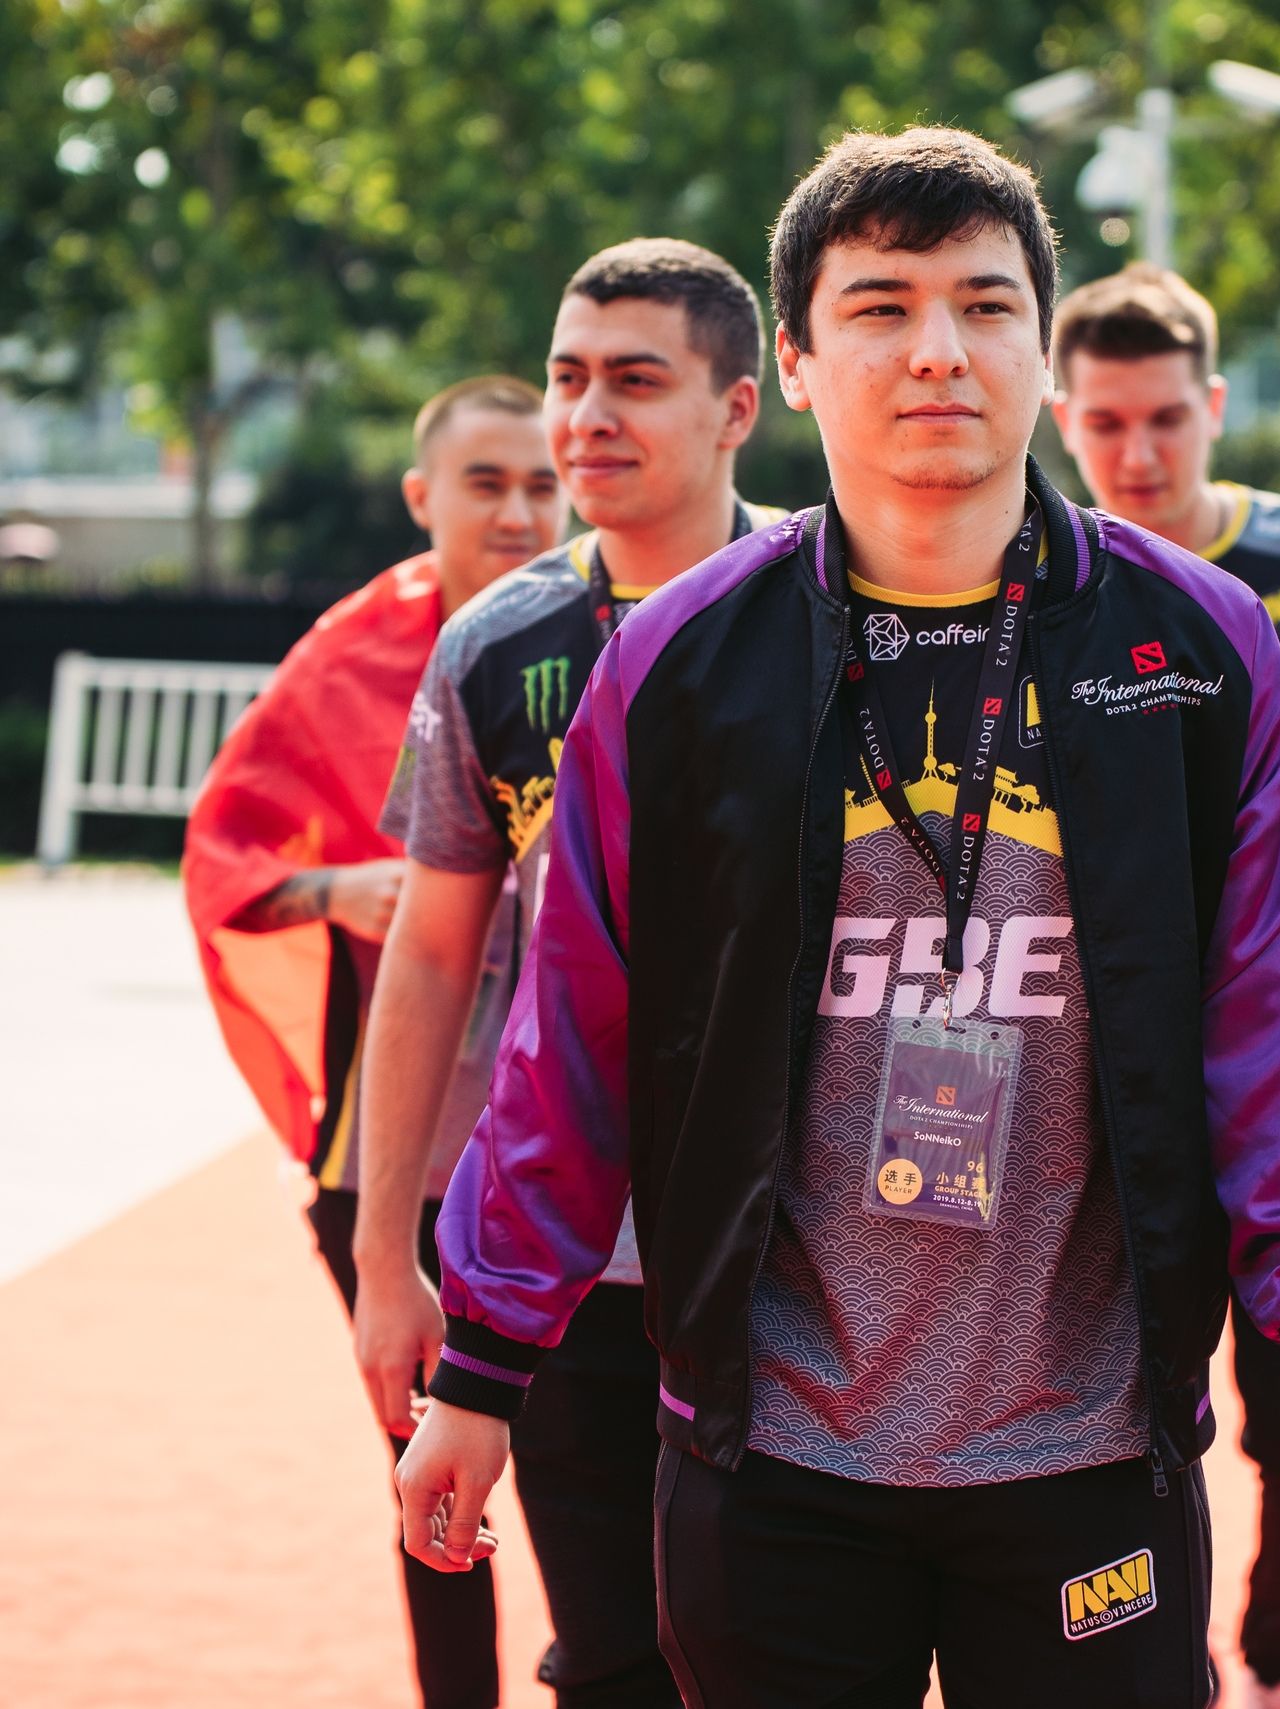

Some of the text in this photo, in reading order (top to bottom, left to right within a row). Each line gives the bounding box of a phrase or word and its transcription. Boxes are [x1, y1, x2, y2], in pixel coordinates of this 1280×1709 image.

[1018, 543, 1031, 552] 2
[996, 605, 1018, 666] DOTA 2
[1071, 672, 1224, 705] The International
[1106, 704, 1131, 715] DOTA
[863, 721, 885, 768] DOTA
[972, 719, 995, 781] DOTA 2
[956, 836, 975, 901] DOTA 2
[893, 1094, 989, 1123] The International
[884, 1169, 917, 1186] 选手
[967, 1161, 984, 1173] 96
[885, 1185, 912, 1194] PLAYER
[934, 1185, 982, 1198] GROUP STAG
[1068, 1554, 1150, 1623] NAVI
[1070, 1594, 1152, 1633] NATUS VINCERE
